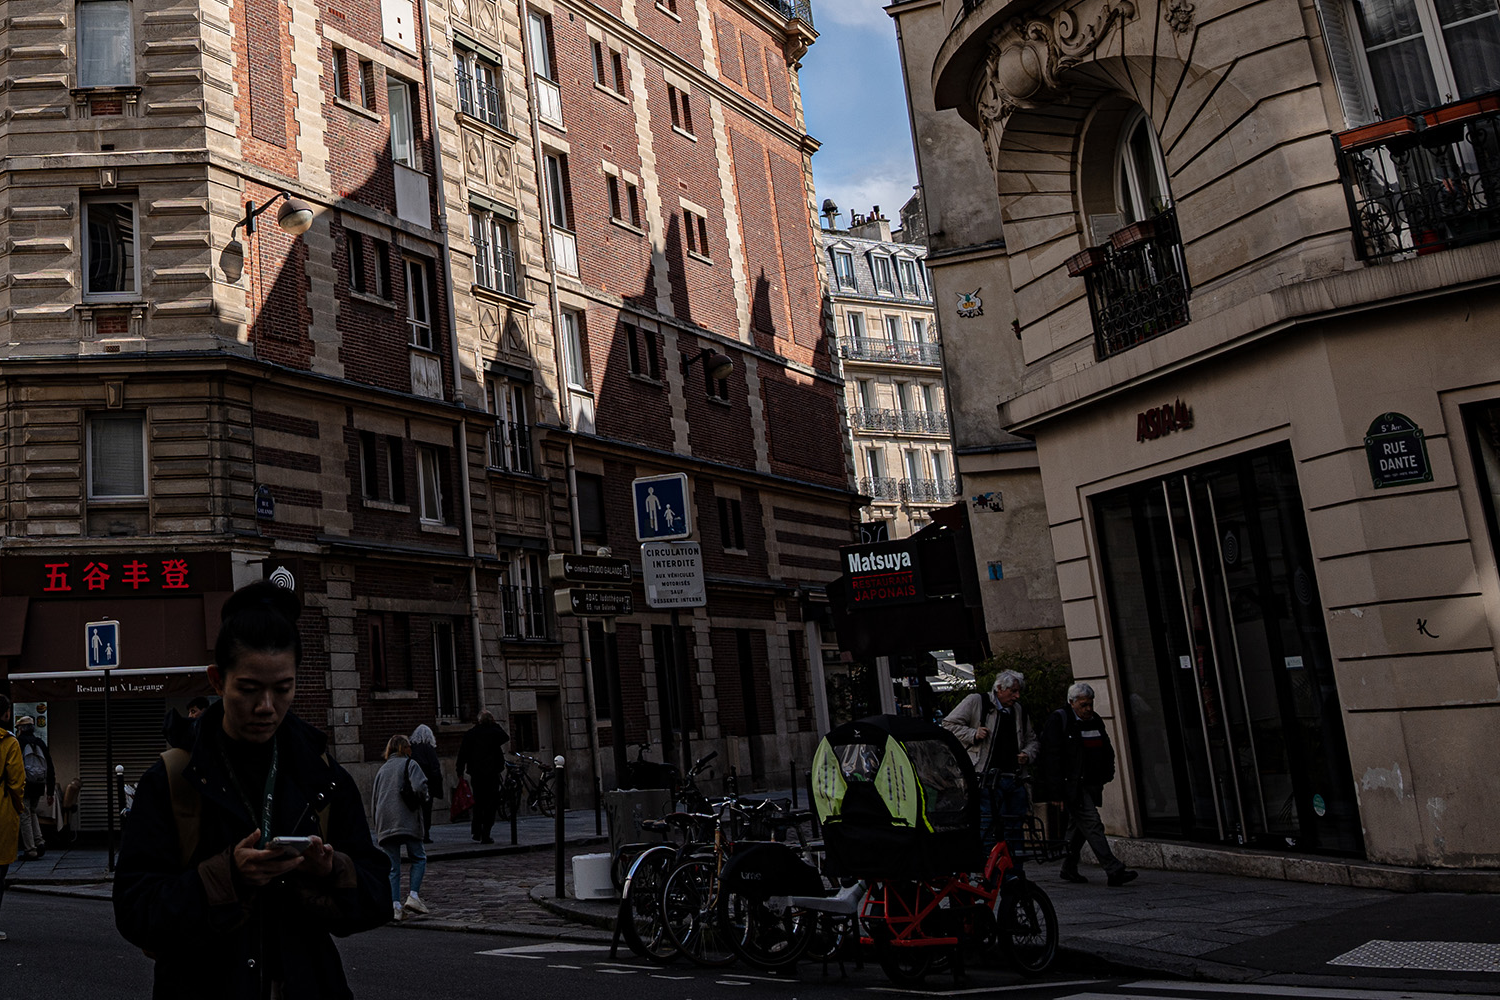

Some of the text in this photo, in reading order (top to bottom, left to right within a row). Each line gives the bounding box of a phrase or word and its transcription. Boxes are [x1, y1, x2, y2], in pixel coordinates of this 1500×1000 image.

[1382, 440, 1408, 455] RUE
[1379, 455, 1418, 472] DANTE
[646, 547, 699, 557] CIRCULATION
[652, 559, 695, 568] INTERDITE
[847, 551, 912, 573] Matsuya
[43, 558, 190, 592] 五谷丰登
[588, 565, 604, 574] STUDIO
[604, 566, 623, 575] GALANDE
[851, 574, 914, 590] RESTAURANT
[854, 584, 916, 602] JAPONAIS
[76, 684, 118, 693] Restaurnt
[128, 683, 164, 694] Lagrange
